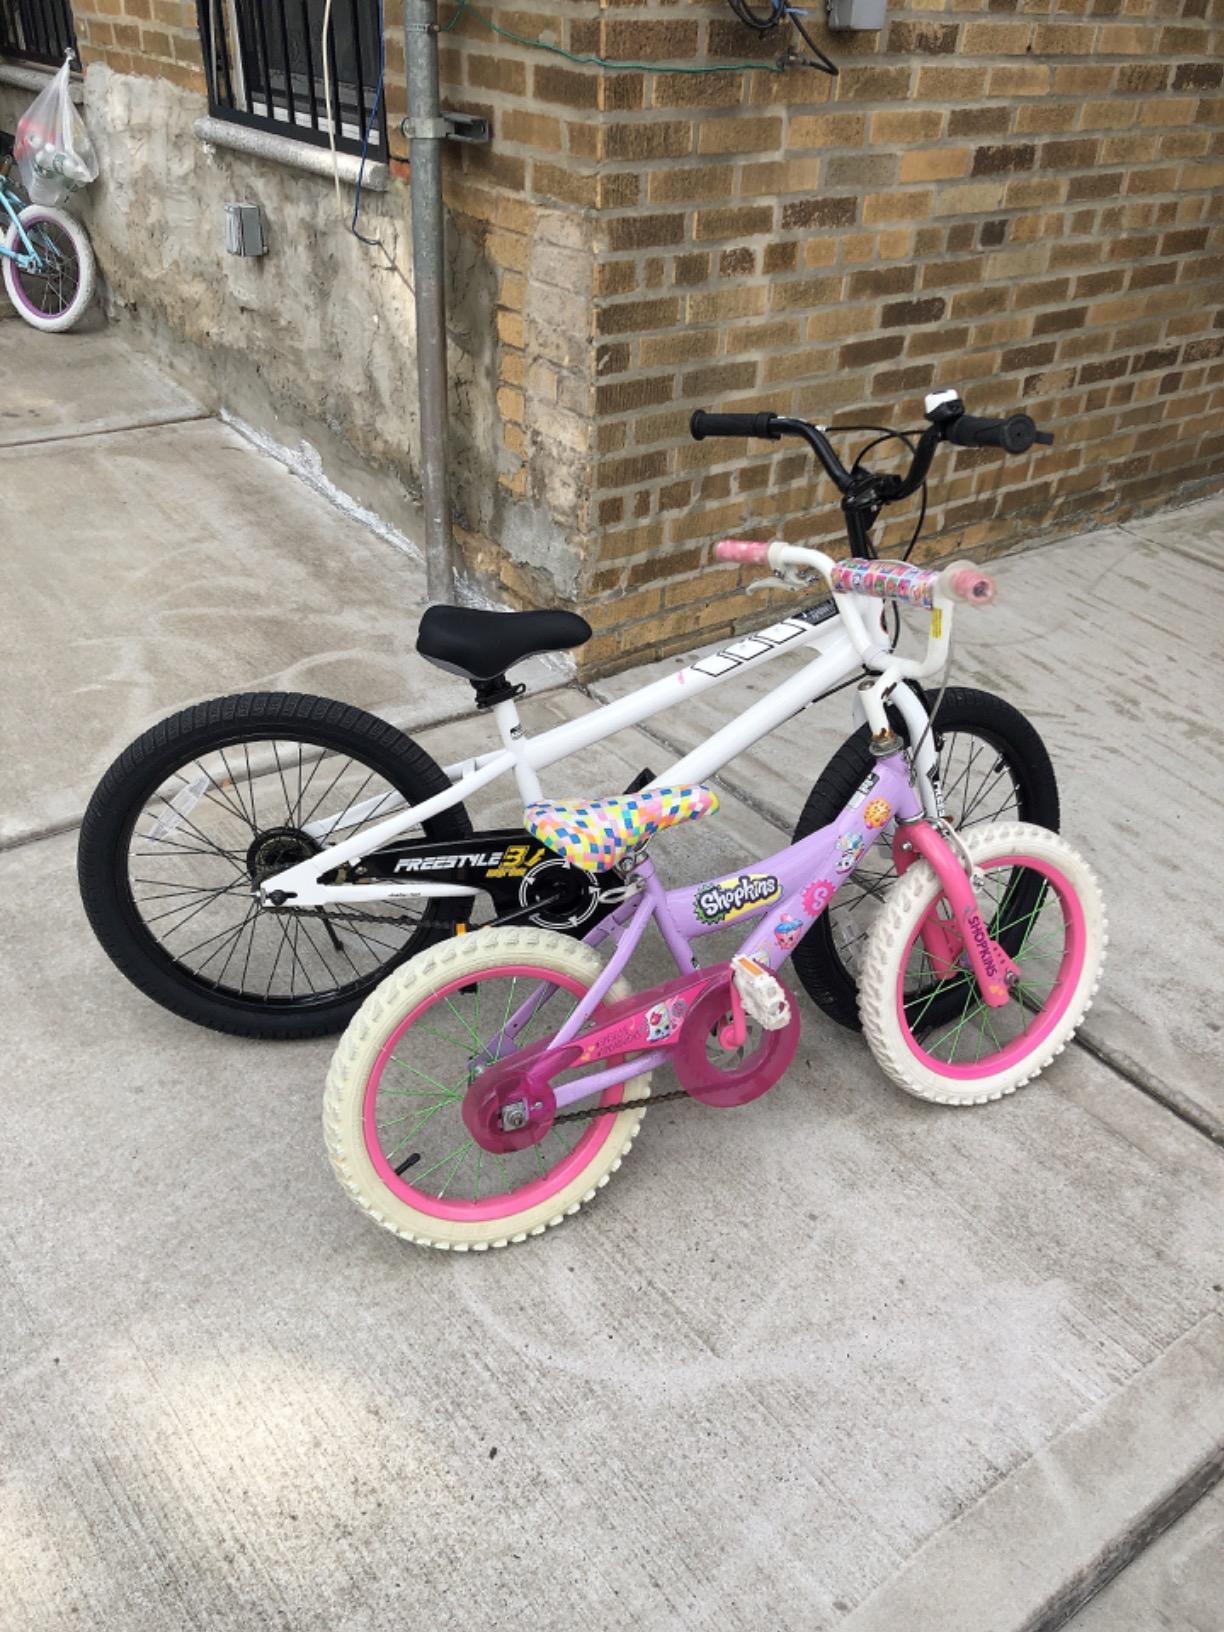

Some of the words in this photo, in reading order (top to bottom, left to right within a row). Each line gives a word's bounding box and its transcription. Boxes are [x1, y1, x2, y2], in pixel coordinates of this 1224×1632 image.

[394, 852, 503, 873] FREESTYLE
[700, 876, 776, 916] Shopkins
[967, 915, 998, 978] SHOPKINS
